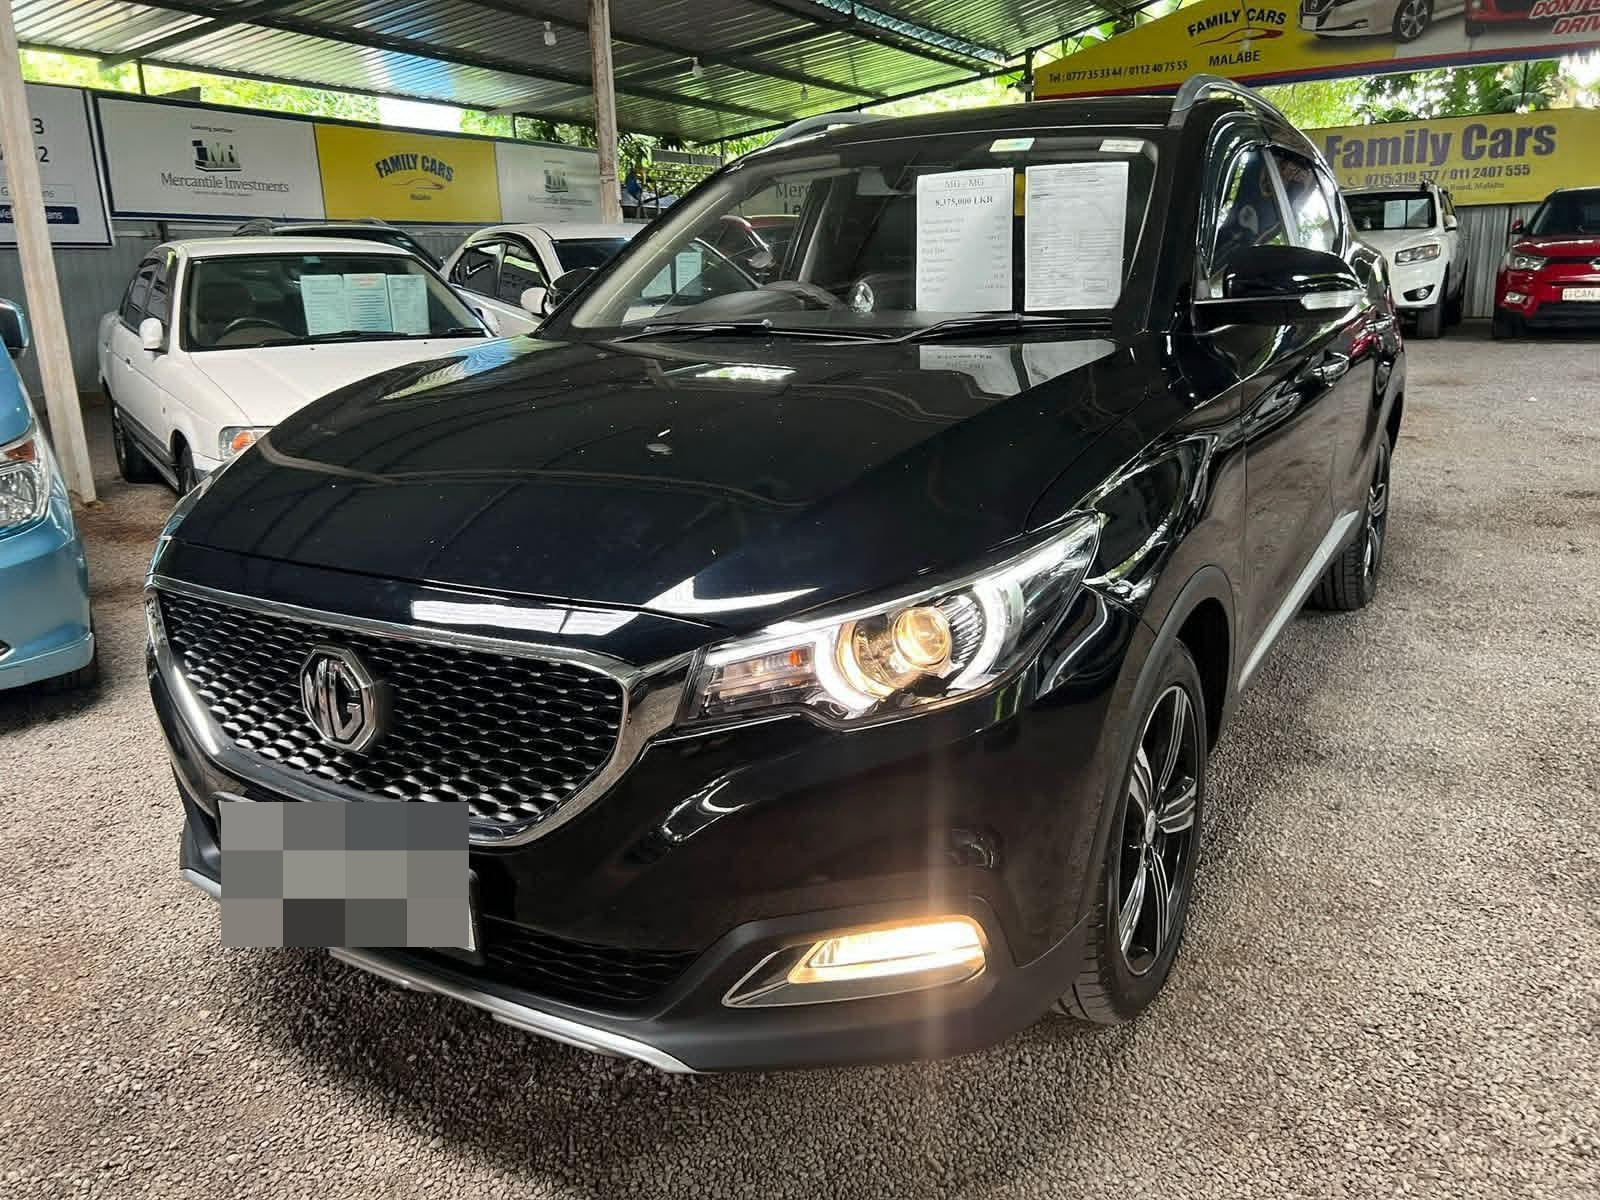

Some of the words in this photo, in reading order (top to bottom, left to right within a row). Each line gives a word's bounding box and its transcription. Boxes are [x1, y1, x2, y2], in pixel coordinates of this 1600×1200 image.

[1187, 9, 1241, 37] FAMILY
[1246, 8, 1287, 25] CARS
[1208, 50, 1261, 67] MALABE
[1066, 71, 1086, 81] 0777
[1326, 127, 1452, 167] Family
[1461, 123, 1557, 161] Cars
[375, 153, 418, 178] FAMILY
[421, 155, 454, 182] CARS
[1450, 168, 1469, 180] 011
[1505, 163, 1531, 177] 555
[160, 171, 223, 189] Mercantile
[225, 176, 289, 193] Investments
[304, 657, 361, 741] MG
